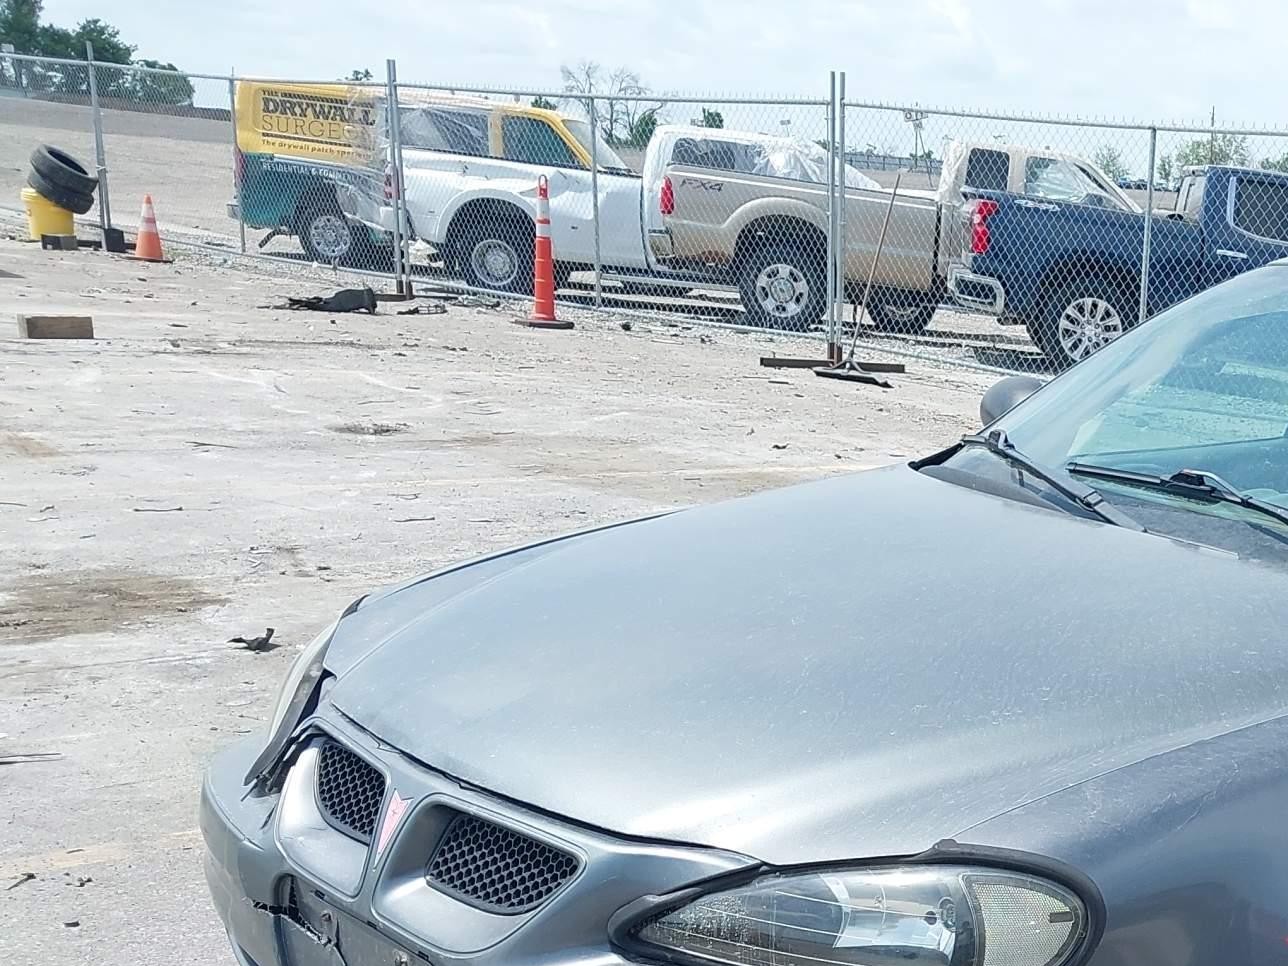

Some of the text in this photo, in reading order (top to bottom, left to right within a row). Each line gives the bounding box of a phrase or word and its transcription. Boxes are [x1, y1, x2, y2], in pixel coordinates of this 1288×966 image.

[262, 89, 279, 97] THE
[262, 97, 376, 126] DRYWALL
[278, 142, 310, 152] drywall
[680, 177, 724, 192] FX4
